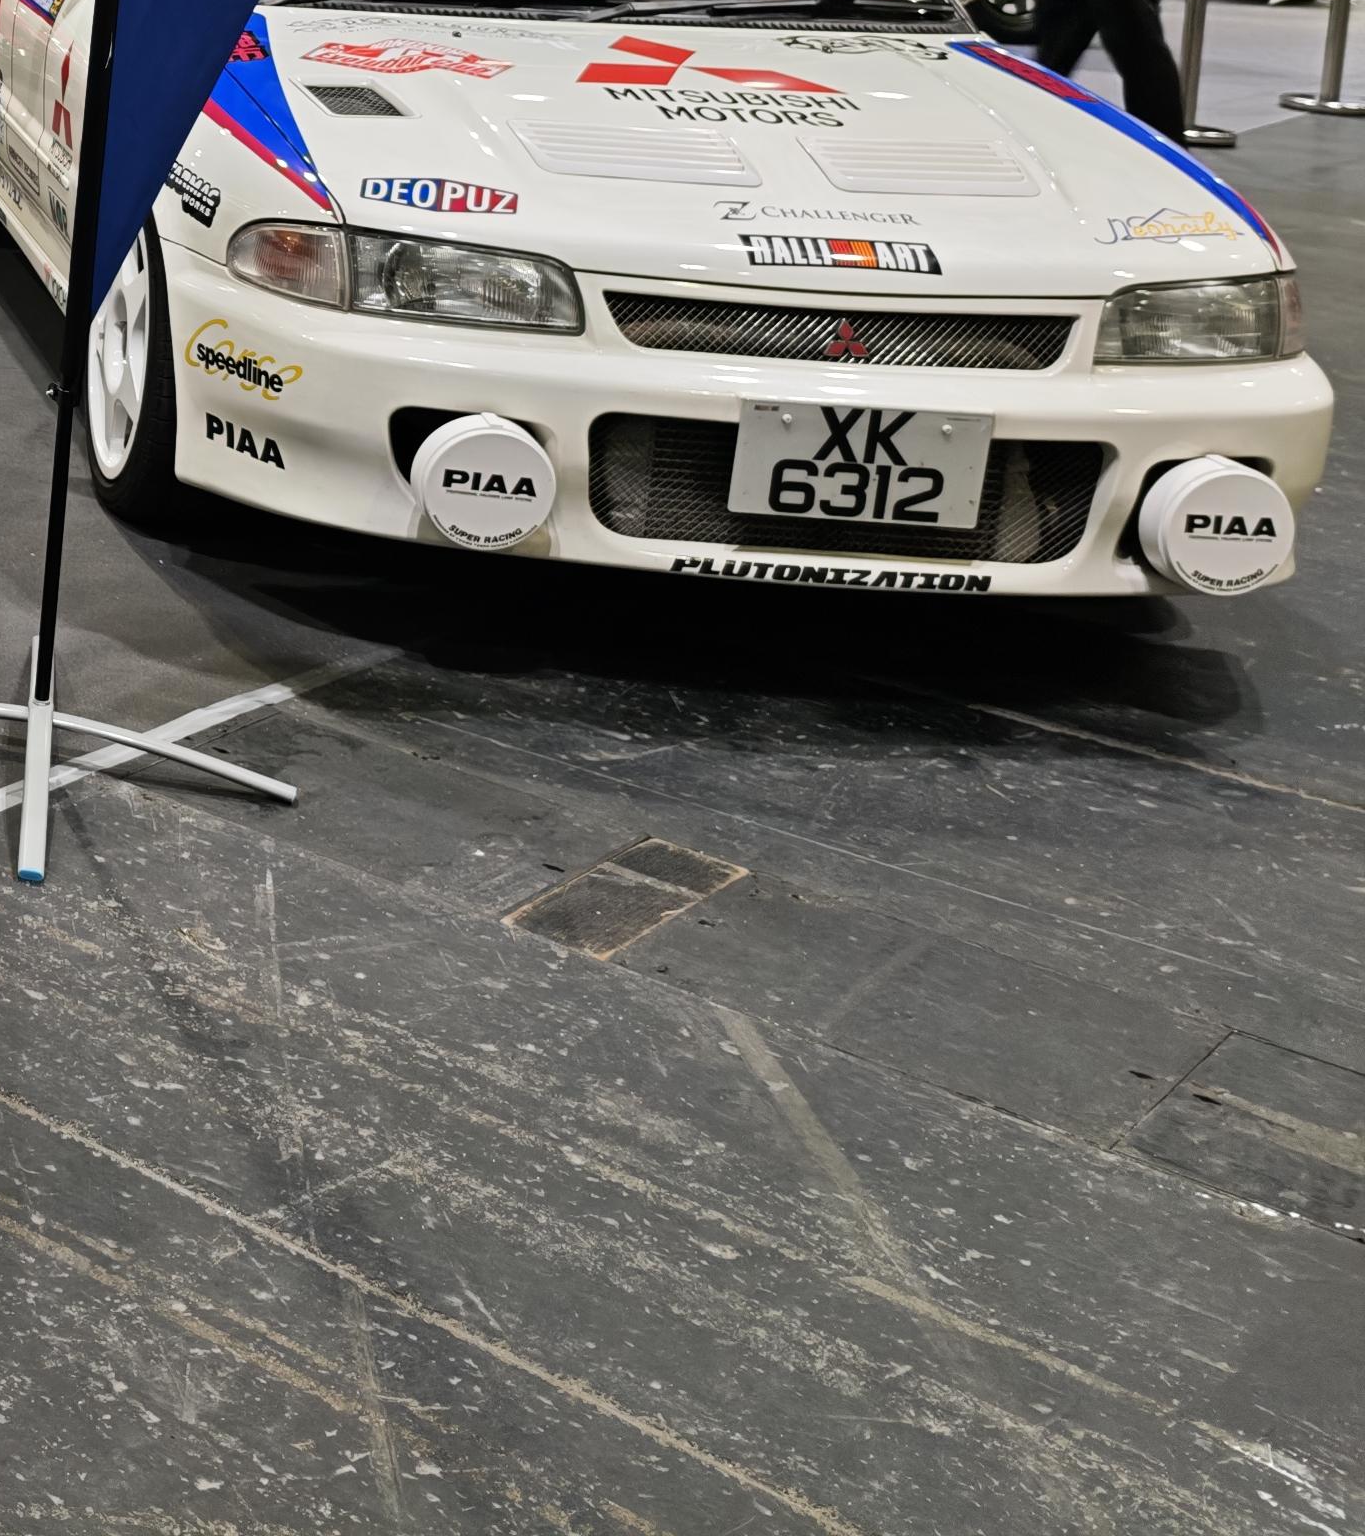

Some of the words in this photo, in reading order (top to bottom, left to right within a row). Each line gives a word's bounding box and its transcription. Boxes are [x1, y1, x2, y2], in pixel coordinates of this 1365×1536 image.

[602, 86, 862, 112] MITSUBISHI
[658, 105, 846, 129] MOTORS
[182, 192, 212, 217] WORKS
[364, 179, 517, 215] DEOPUZ
[749, 235, 829, 266] RALLI
[876, 242, 931, 273] ART
[196, 342, 285, 394] speedline
[205, 412, 286, 470] PIAA
[812, 405, 918, 466] XK
[442, 468, 537, 498] PIAA
[767, 458, 947, 525] 6312
[447, 524, 481, 544] SUPER
[483, 527, 523, 544] RACING
[1184, 513, 1277, 538] PIAA
[669, 558, 993, 593] PLUTONIZATION
[1190, 569, 1223, 587] SUPER
[1226, 568, 1264, 587] RACING
